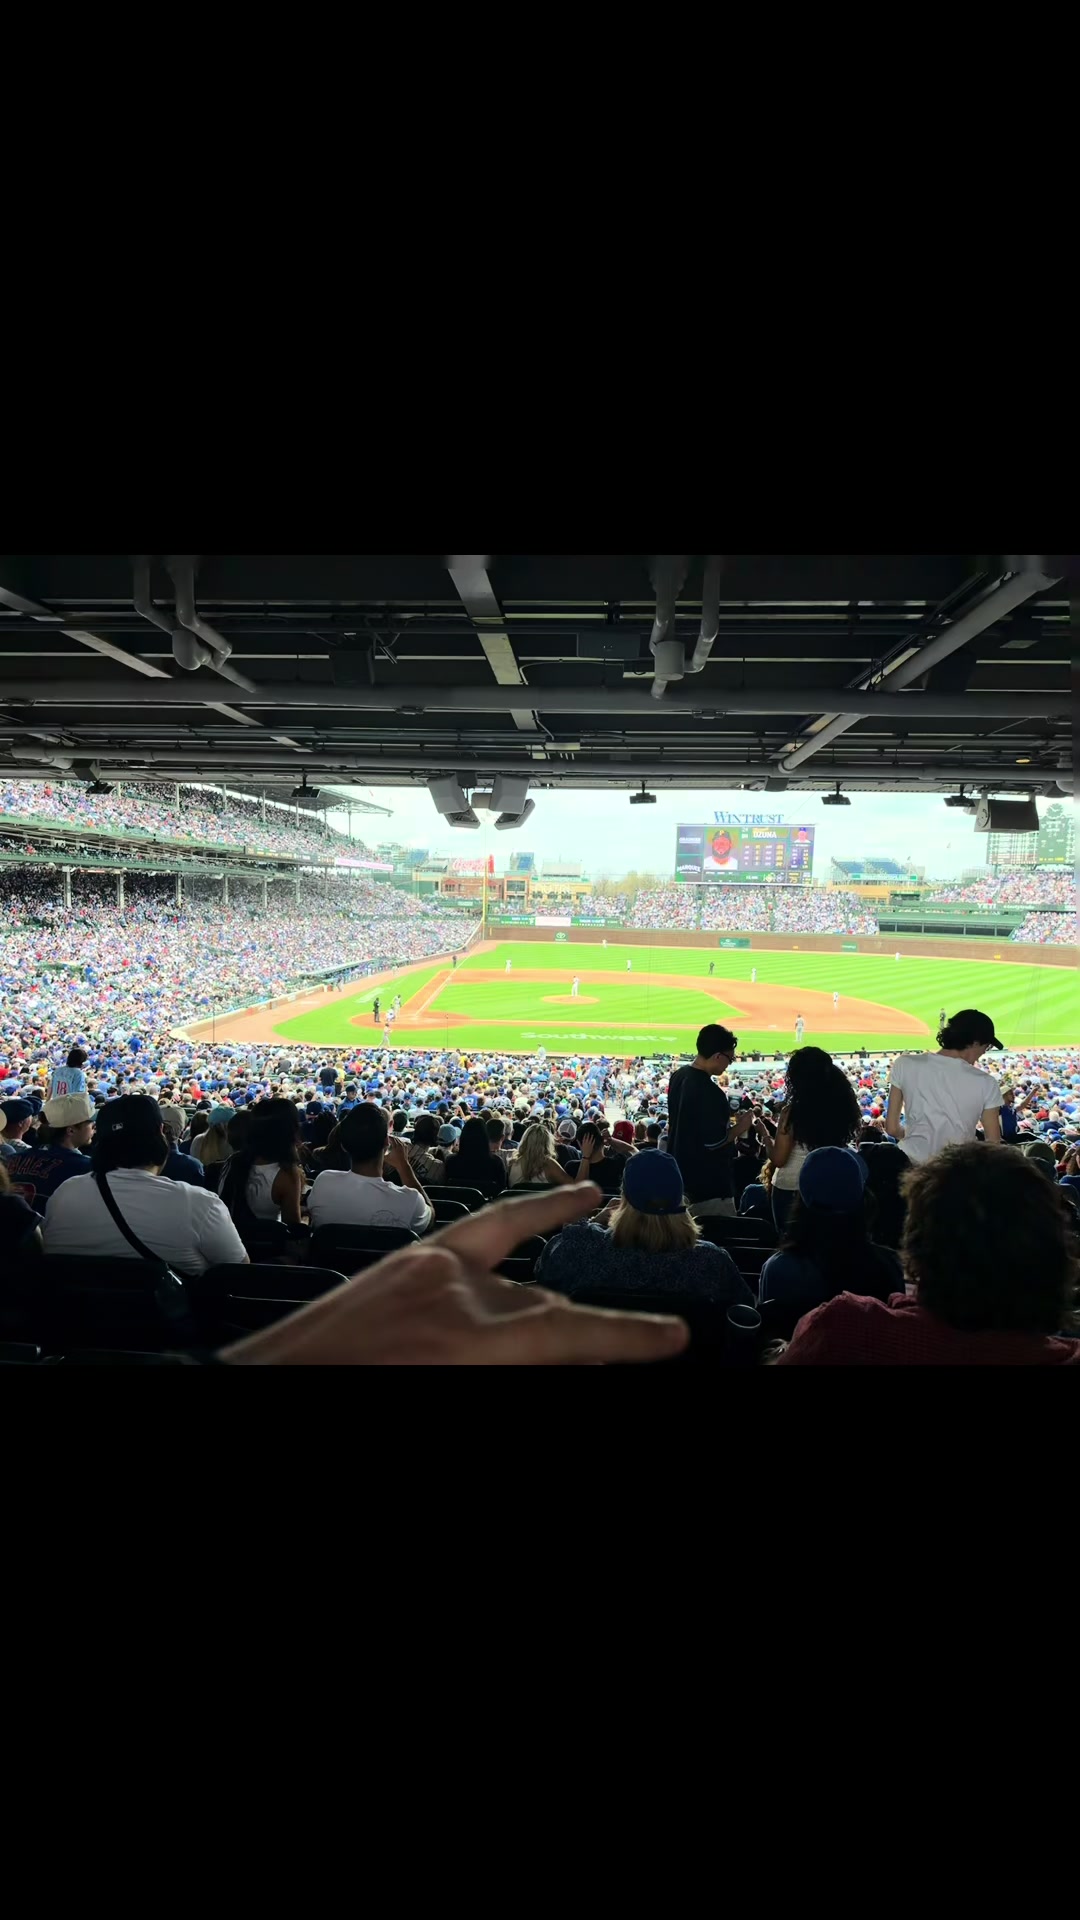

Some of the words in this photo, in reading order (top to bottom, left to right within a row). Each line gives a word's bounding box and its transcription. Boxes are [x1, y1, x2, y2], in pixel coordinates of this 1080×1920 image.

[713, 811, 784, 824] WINTRUST
[520, 1032, 658, 1042] Southwest
[57, 1081, 67, 1095] 18
